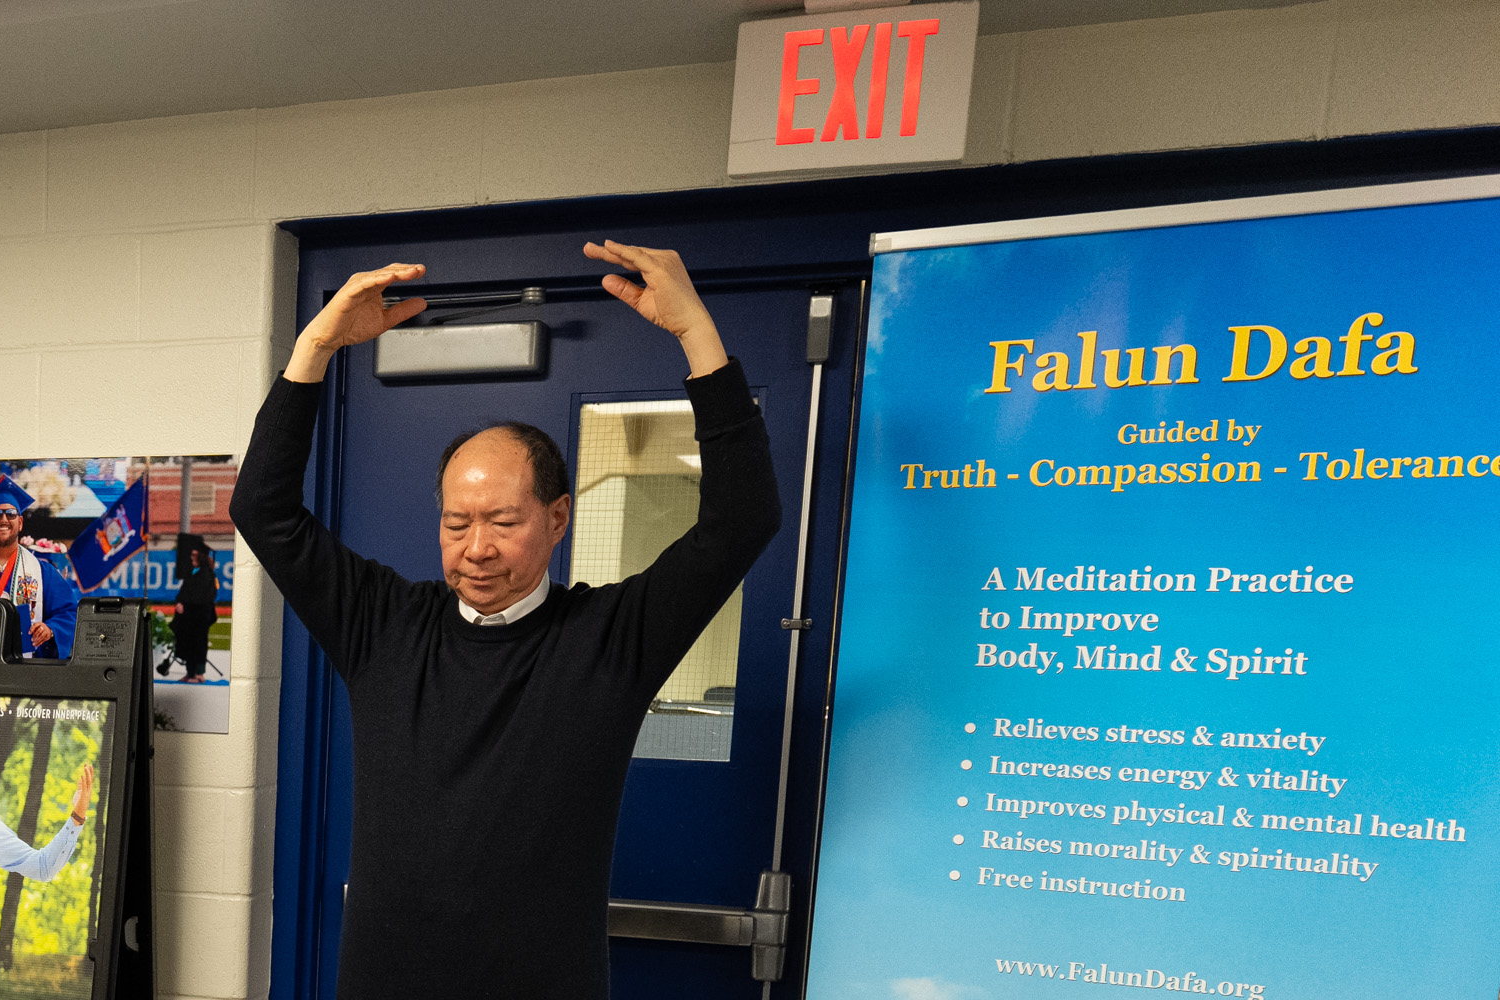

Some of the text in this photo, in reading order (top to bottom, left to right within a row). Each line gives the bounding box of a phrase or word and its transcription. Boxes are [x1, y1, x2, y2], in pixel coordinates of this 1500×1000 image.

[775, 18, 940, 146] EXIT
[984, 312, 1418, 393] Falun Dafa
[1118, 419, 1261, 446] Guided by
[901, 459, 997, 490] Truth
[1029, 453, 1262, 492] Compassion
[982, 566, 1354, 594] A Meditation Practice
[979, 607, 1159, 637] to Improve
[975, 644, 1309, 680] Body, Mind & Spirit
[16, 707, 51, 719] DISCOVER
[53, 708, 75, 720] INNER
[77, 709, 99, 721] PEACE
[993, 718, 1326, 755] Relieves stress & anxiety
[989, 756, 1347, 797] Increases energy & vitality
[985, 793, 1467, 843] Improves physical & mental health
[981, 830, 1379, 882] Raises morality & spirituality
[976, 867, 1186, 902] Free instruction
